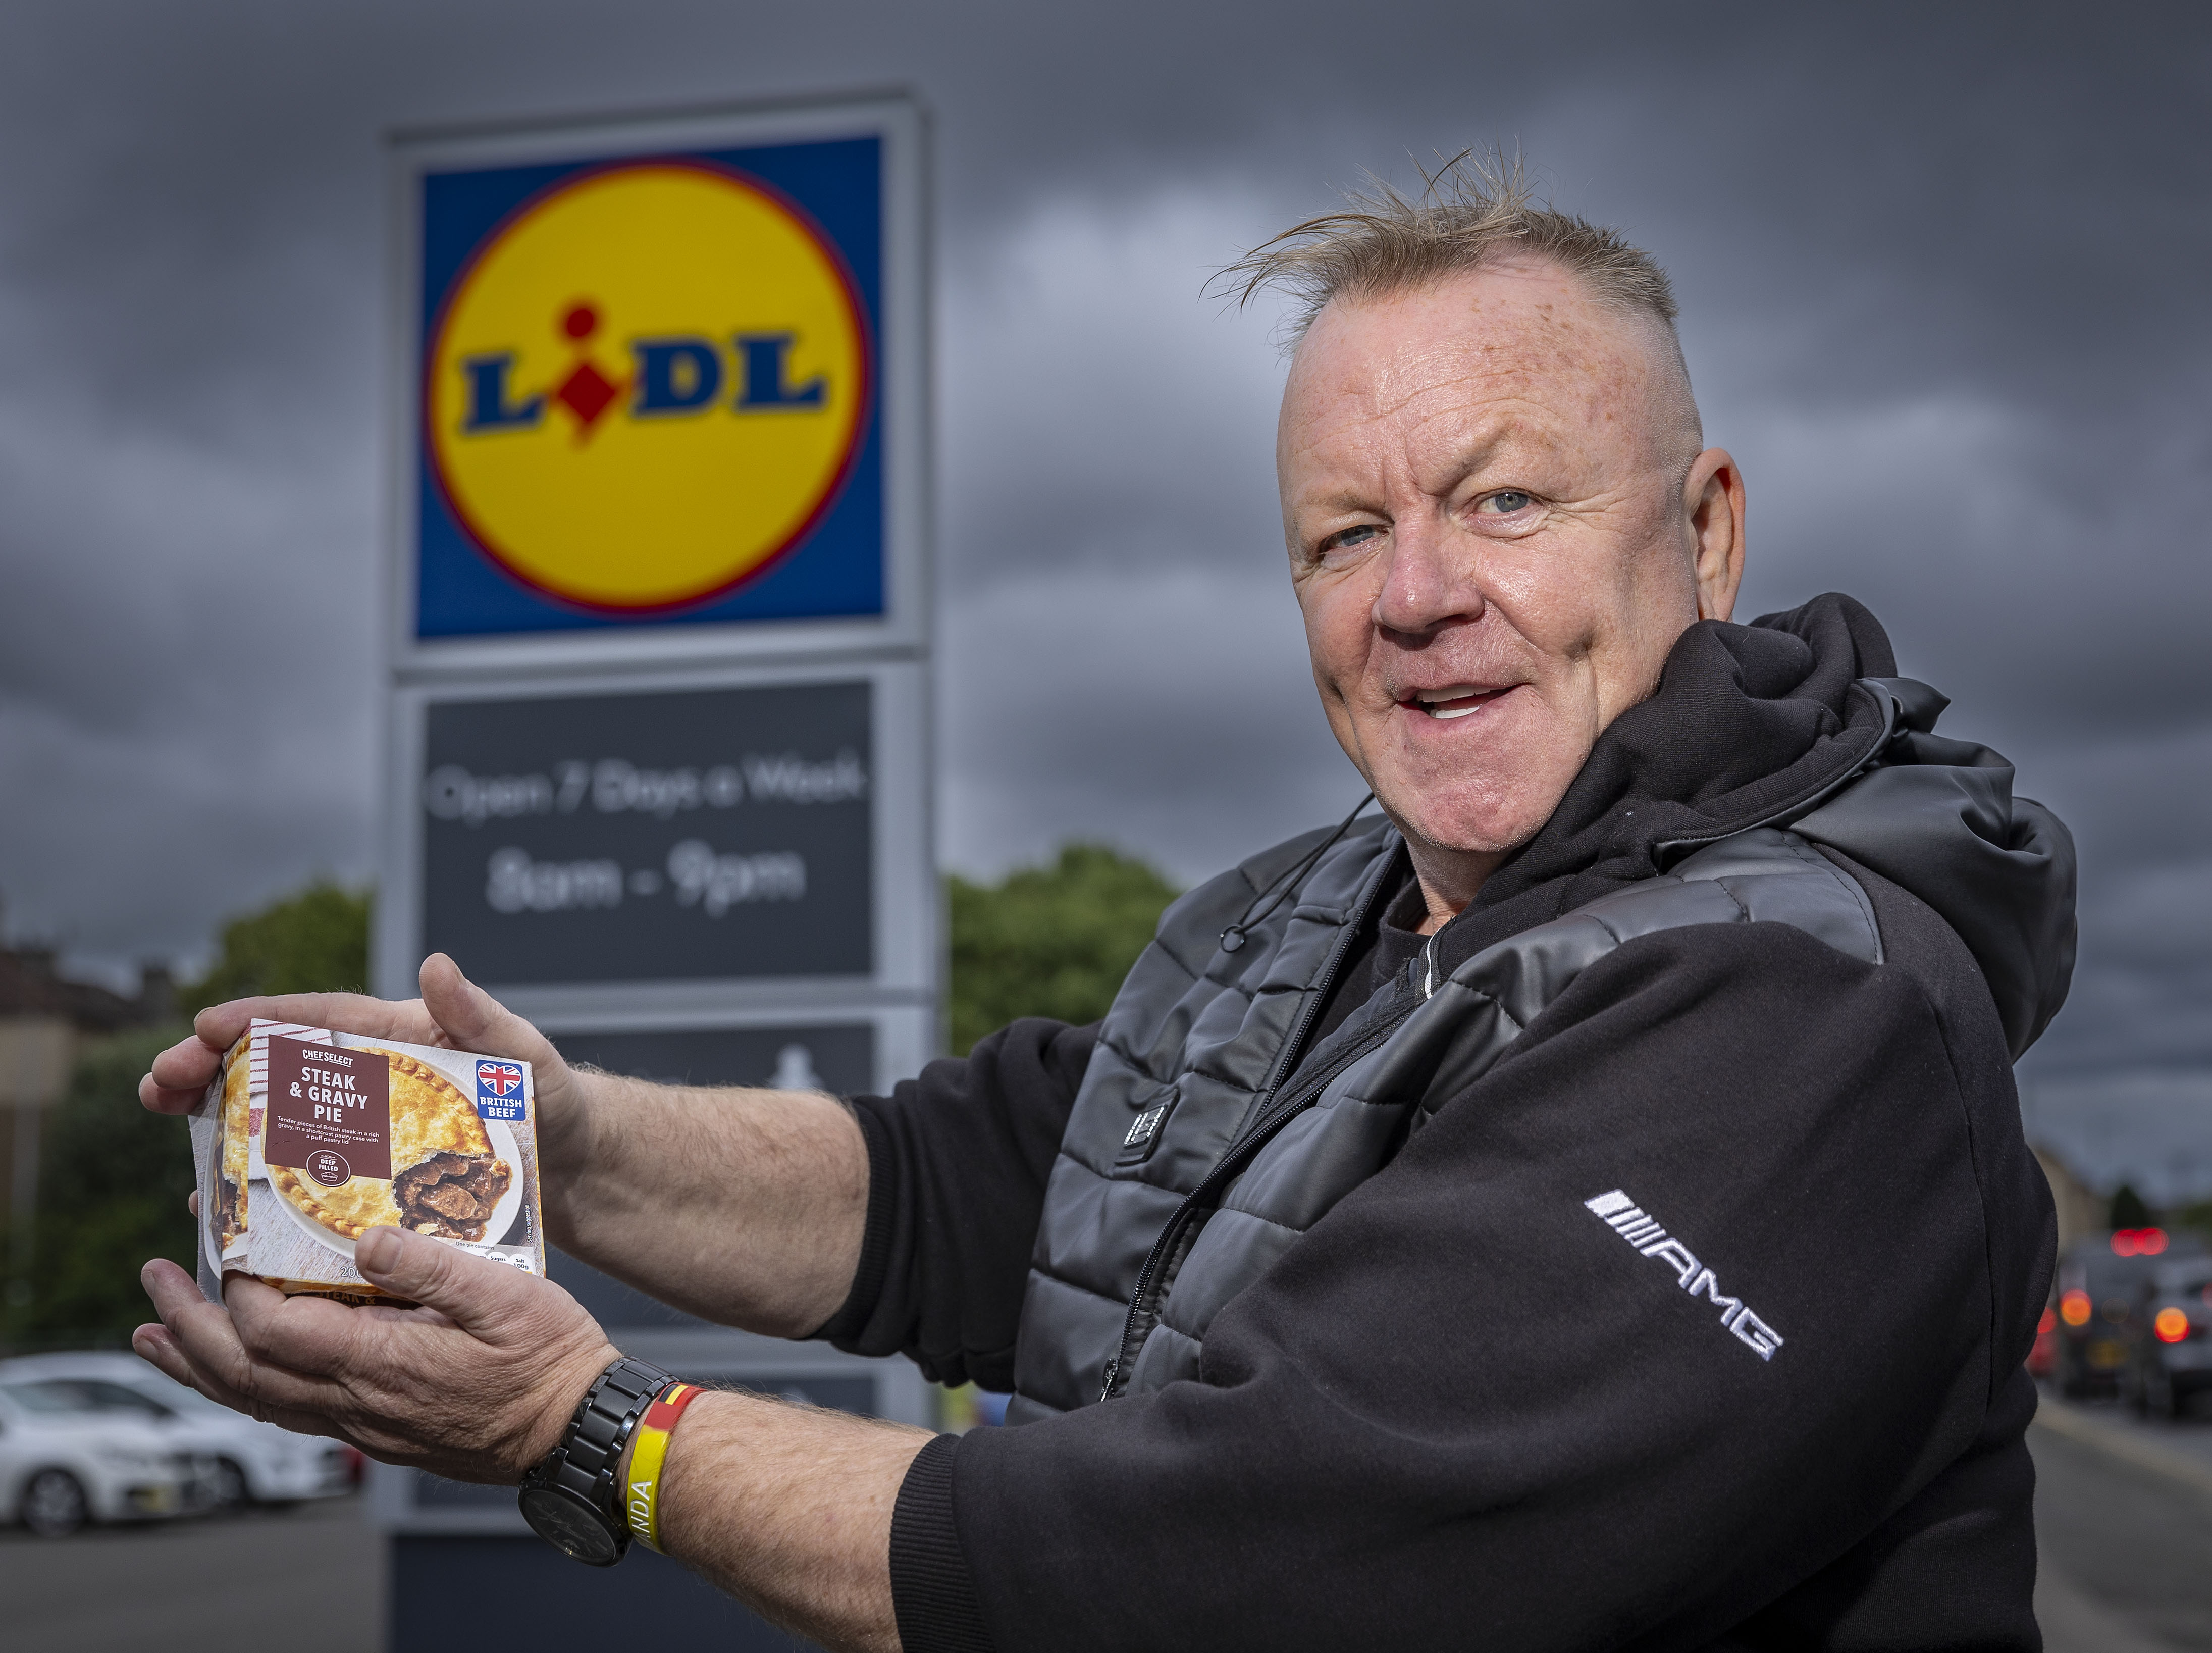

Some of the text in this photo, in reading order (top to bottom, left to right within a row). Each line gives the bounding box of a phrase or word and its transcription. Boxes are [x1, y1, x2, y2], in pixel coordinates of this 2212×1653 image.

[427, 749, 864, 827] Open 7 Days a Week
[487, 848, 622, 912] 8am
[668, 841, 805, 918] 9pm
[302, 1049, 353, 1067] CHEF SELECT
[301, 1067, 355, 1091] STEAK
[290, 1082, 368, 1109] & GRAVY
[480, 1097, 522, 1108] BRITISH
[277, 1116, 296, 1124] Tender
[314, 1104, 342, 1123] PIE
[488, 1107, 515, 1117] BEEF
[306, 1128, 333, 1137] shortcrust
